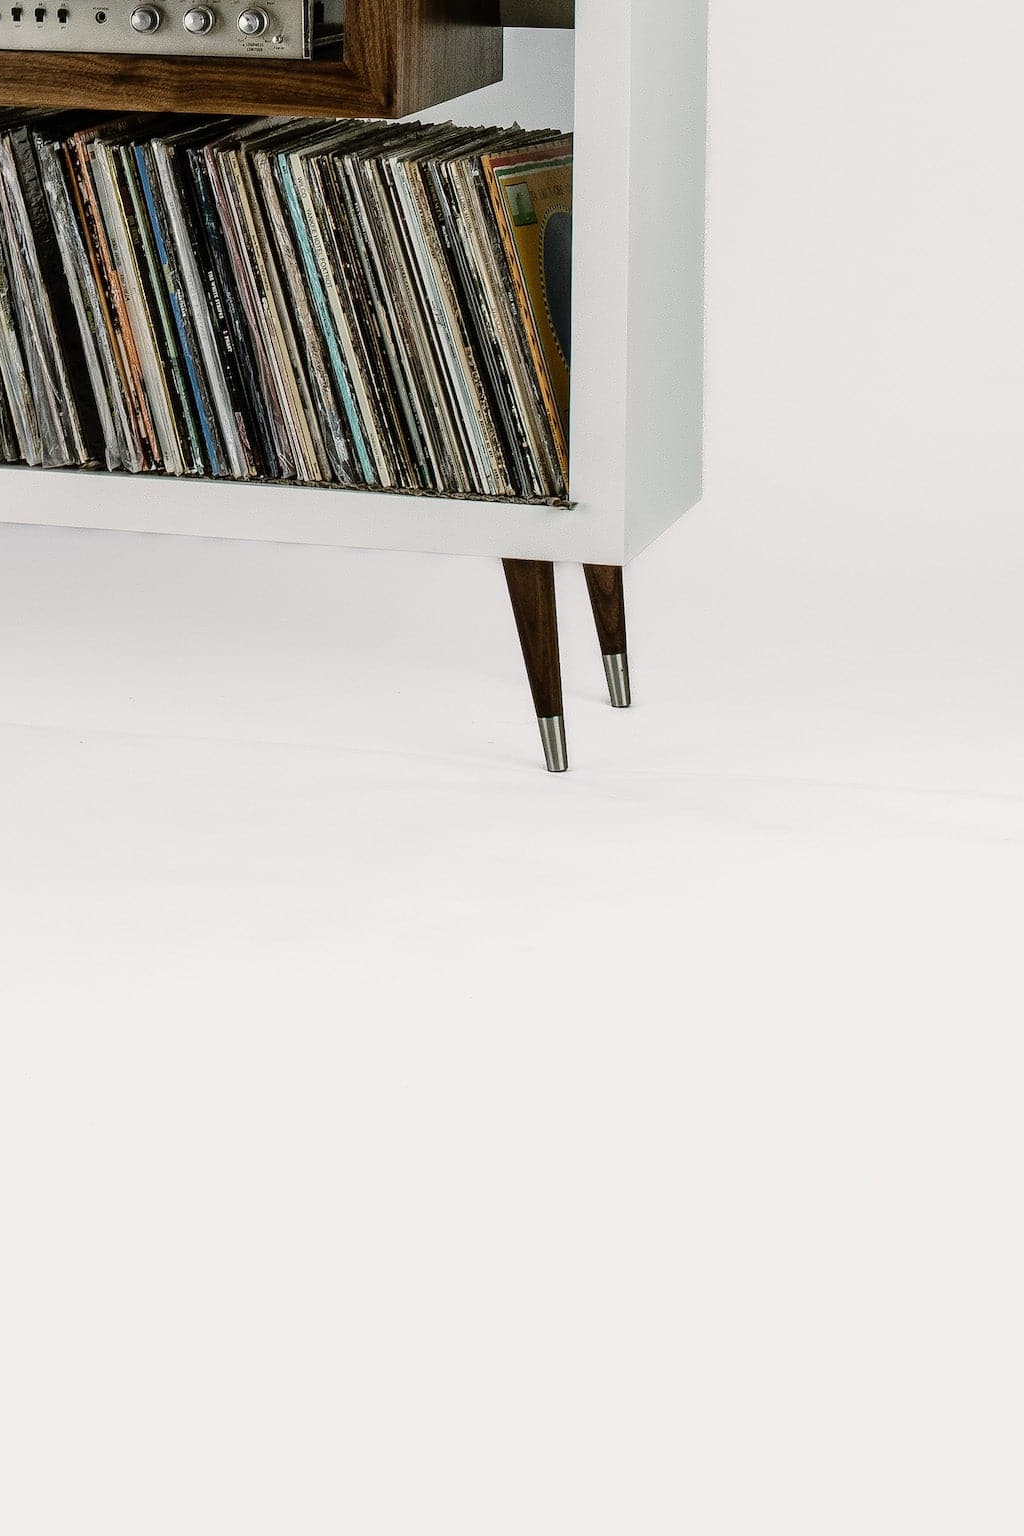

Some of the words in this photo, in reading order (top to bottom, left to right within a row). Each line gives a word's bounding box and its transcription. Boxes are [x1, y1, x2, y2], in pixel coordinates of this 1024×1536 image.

[297, 176, 307, 199] WILCO
[306, 207, 316, 234] YANKEE
[313, 234, 322, 256] HOTEL
[320, 257, 332, 288] FOXTROT
[211, 281, 219, 298] WHITE
[215, 299, 224, 319] STRIPES
